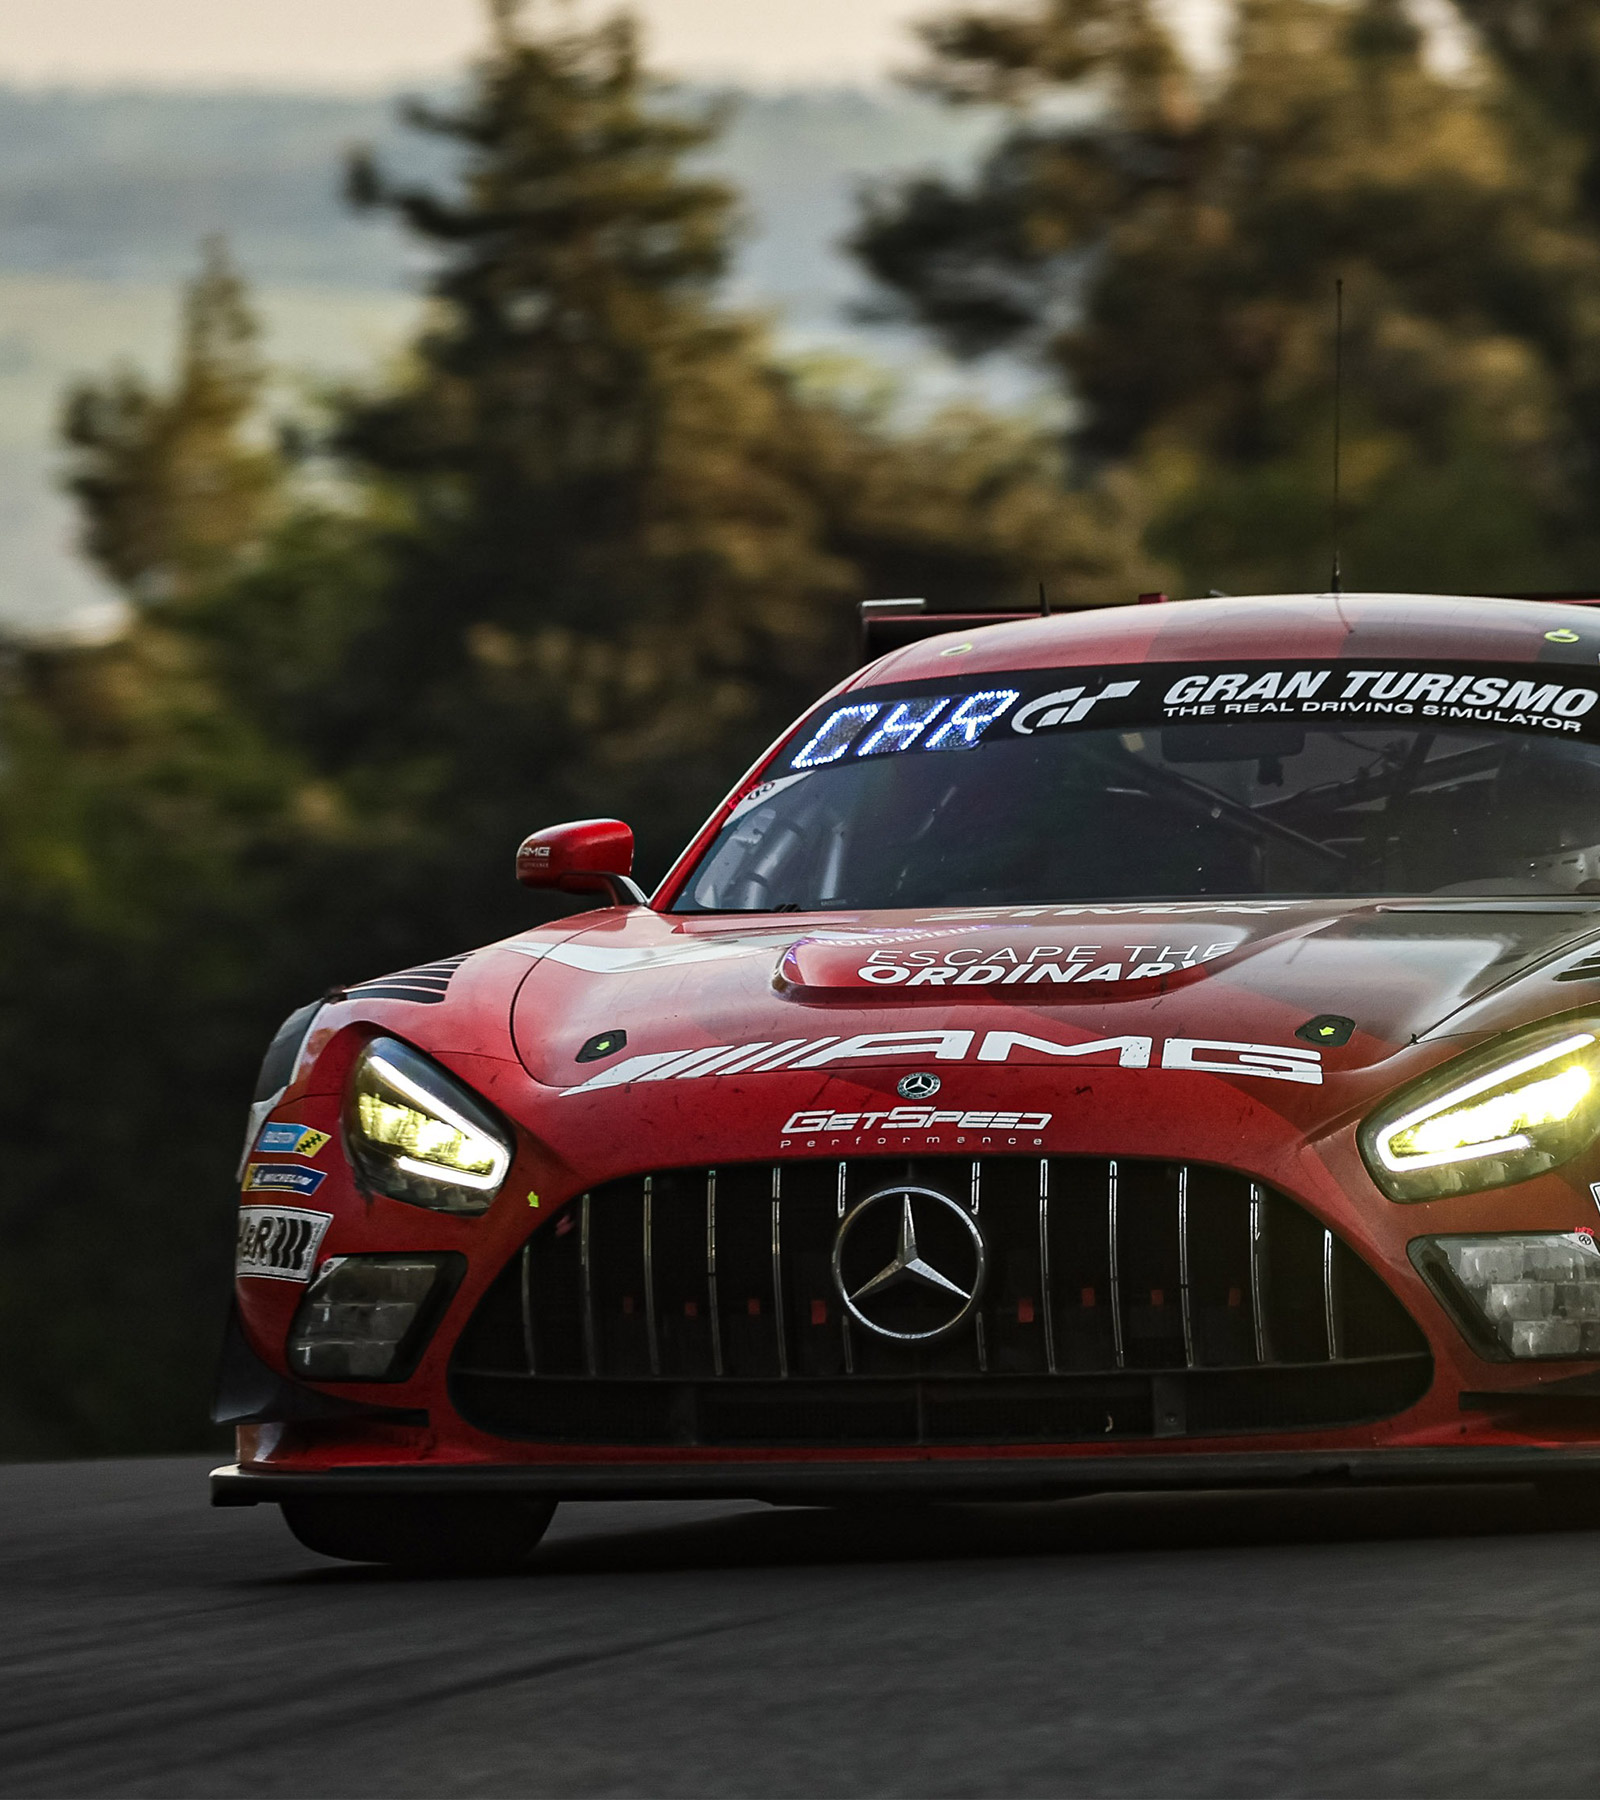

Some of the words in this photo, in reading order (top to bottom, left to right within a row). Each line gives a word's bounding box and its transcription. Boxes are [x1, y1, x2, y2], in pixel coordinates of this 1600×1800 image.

[1162, 671, 1331, 706] GRAN
[1339, 671, 1599, 718] TURISMO
[1163, 705, 1216, 718] THE
[1224, 702, 1295, 714] REAL
[1302, 700, 1414, 716] DRIVING
[1422, 705, 1582, 733] SIMULATOR
[865, 944, 1101, 967] ESCAPE
[1124, 941, 1238, 963] THE
